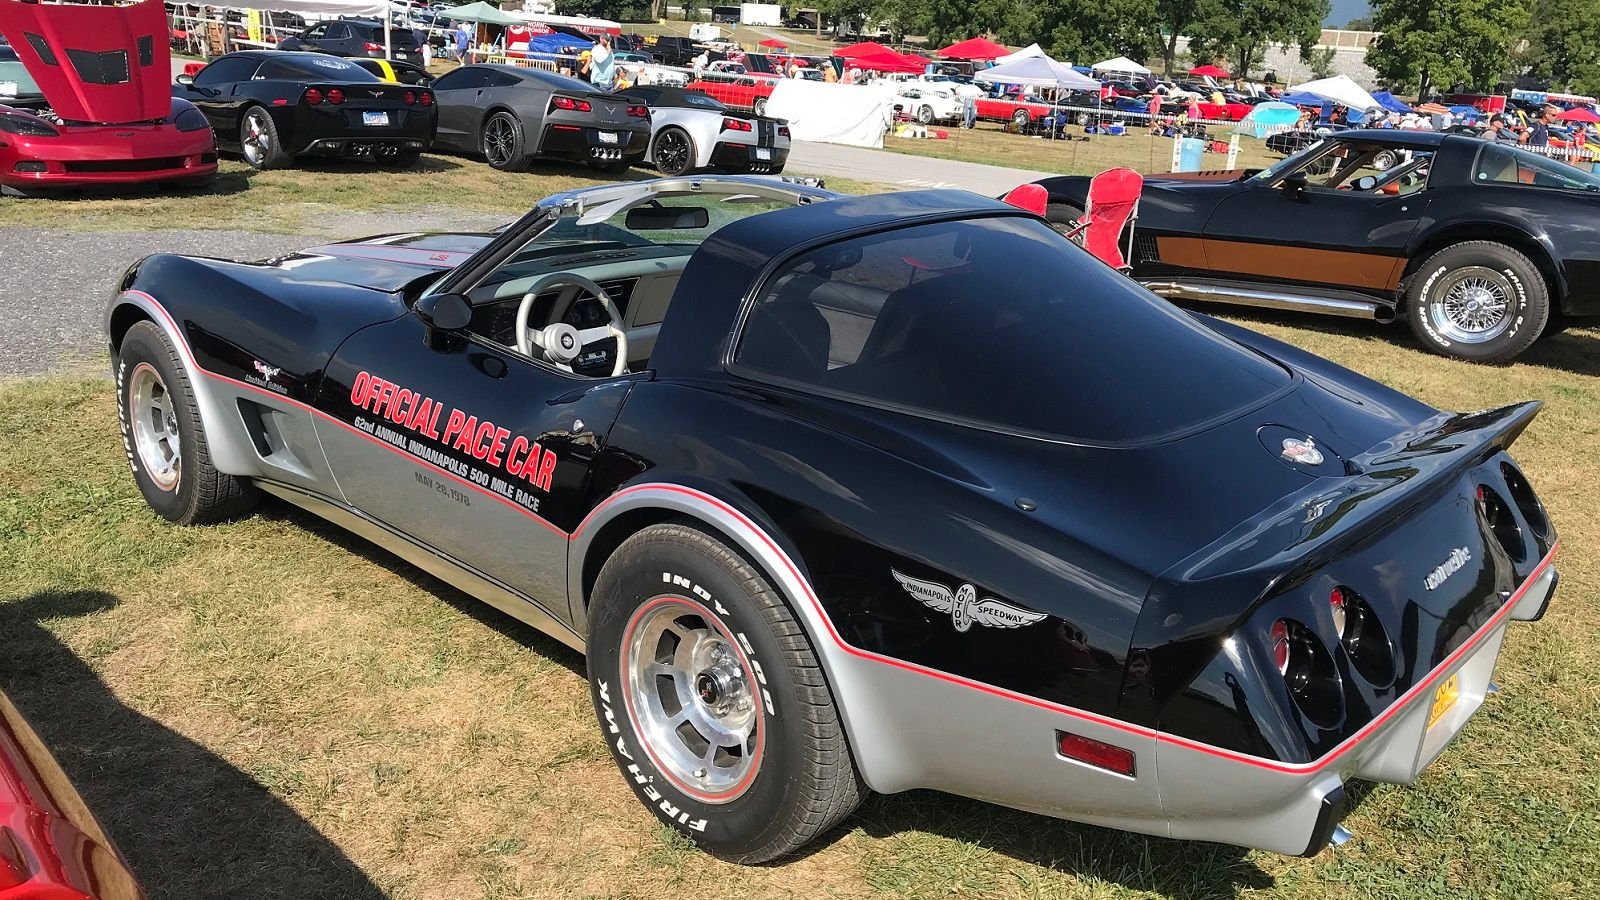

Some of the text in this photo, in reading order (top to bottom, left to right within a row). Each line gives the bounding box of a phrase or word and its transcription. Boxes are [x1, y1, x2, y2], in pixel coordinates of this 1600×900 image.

[1419, 265, 1451, 347] COOPER COBRA
[1504, 268, 1526, 310] RADIAL
[350, 370, 558, 493] OFFICIAL PACE CAR
[354, 415, 540, 513] 62nd ANNUAL INDIANAPOLIS 500 MILE RACE
[414, 471, 434, 488] MAY
[662, 571, 776, 717] INDY 500
[906, 581, 1024, 629] INDIANAPOLIS MOTOR SPEEDWAY
[597, 677, 709, 834] FIREHAWK
